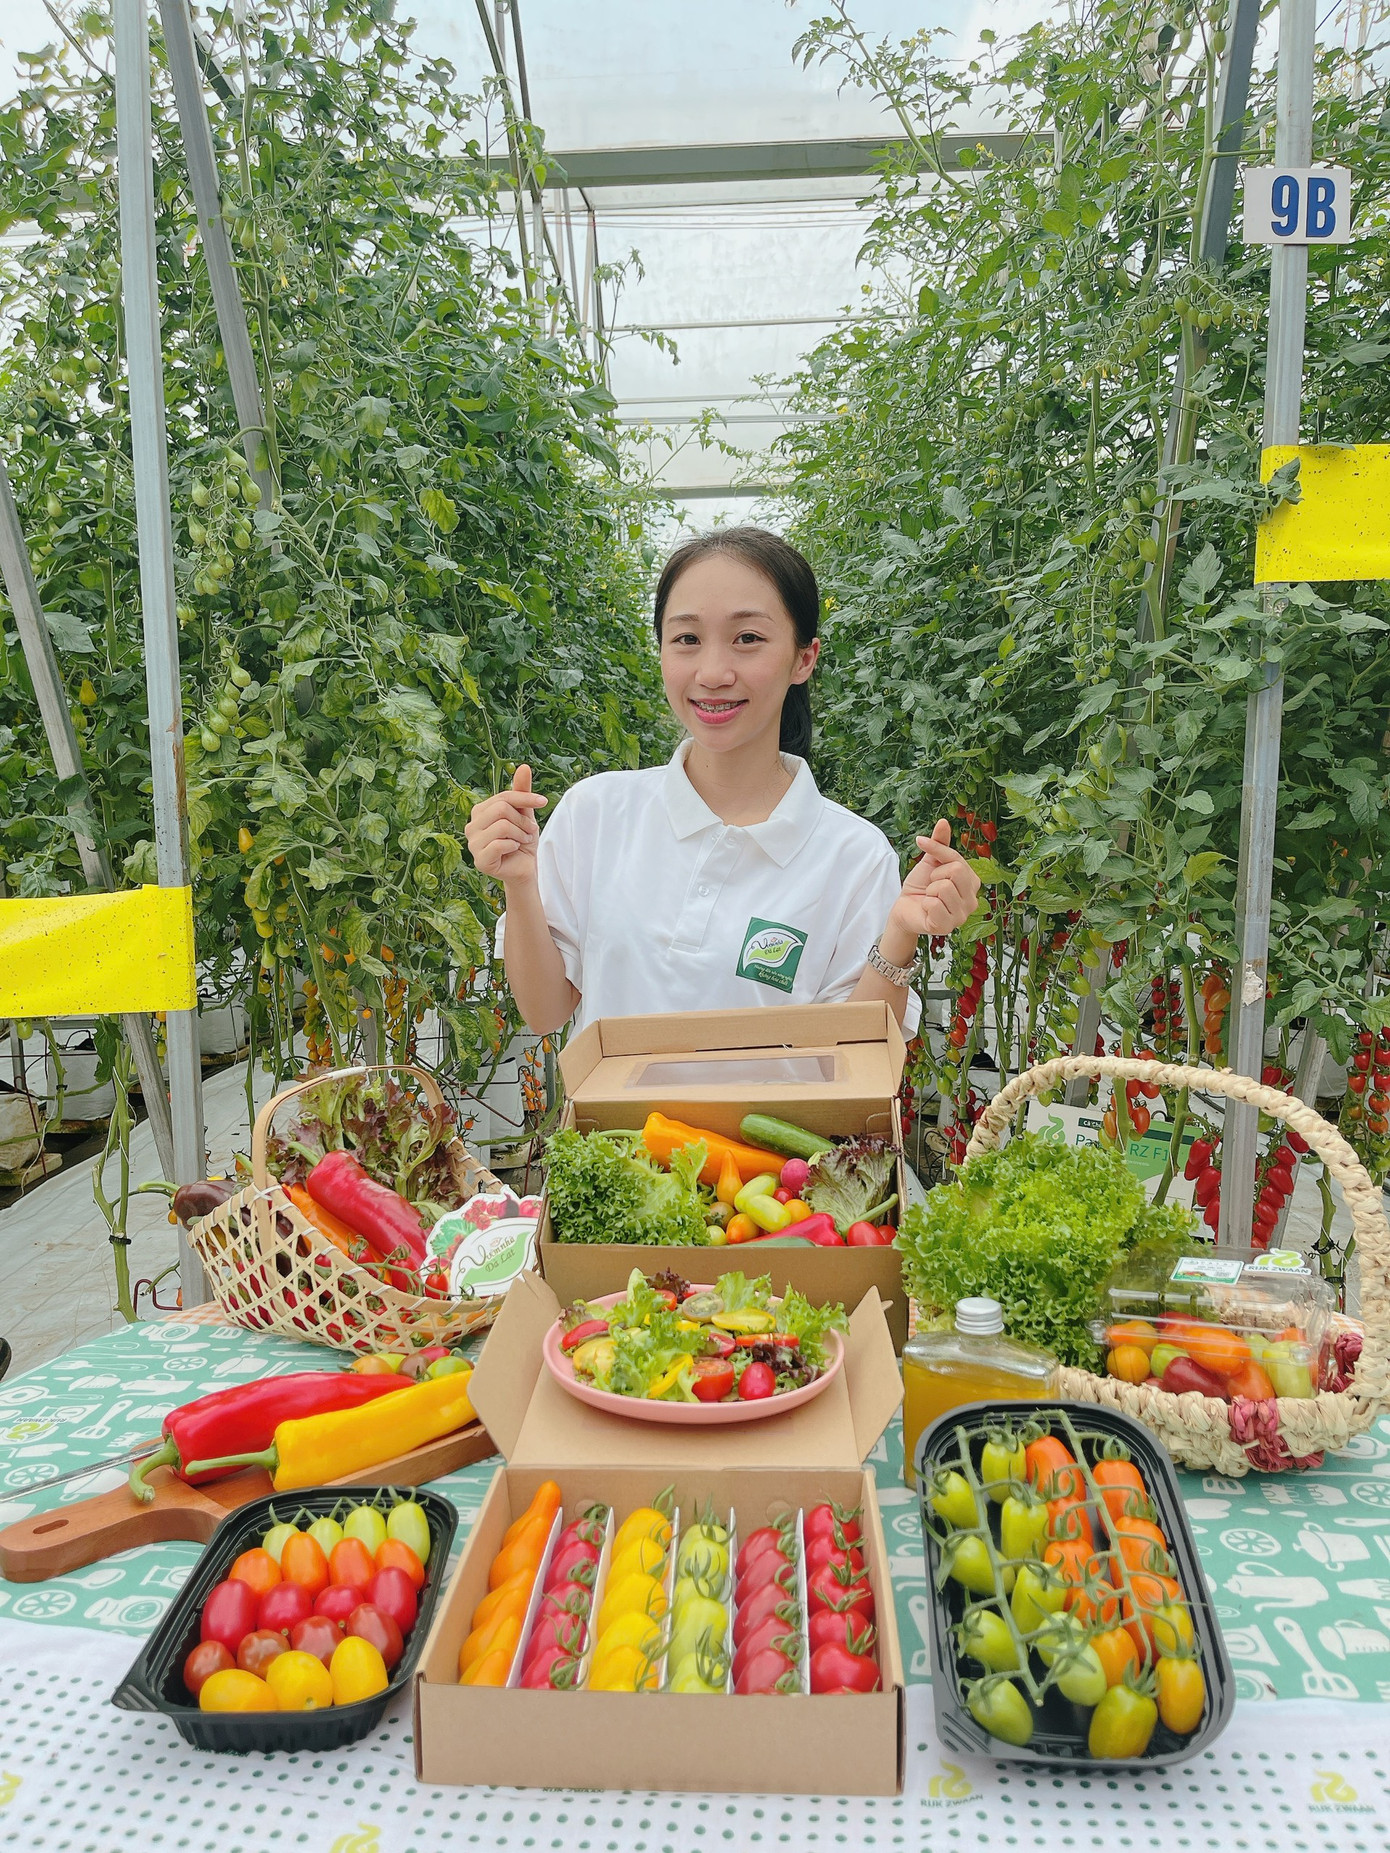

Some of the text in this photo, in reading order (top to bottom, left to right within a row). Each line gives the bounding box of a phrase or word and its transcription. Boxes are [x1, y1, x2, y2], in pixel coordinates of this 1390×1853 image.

[1271, 175, 1336, 238] 9B
[1129, 1143, 1150, 1158] RZ
[1271, 1266, 1309, 1274] ZWAAN
